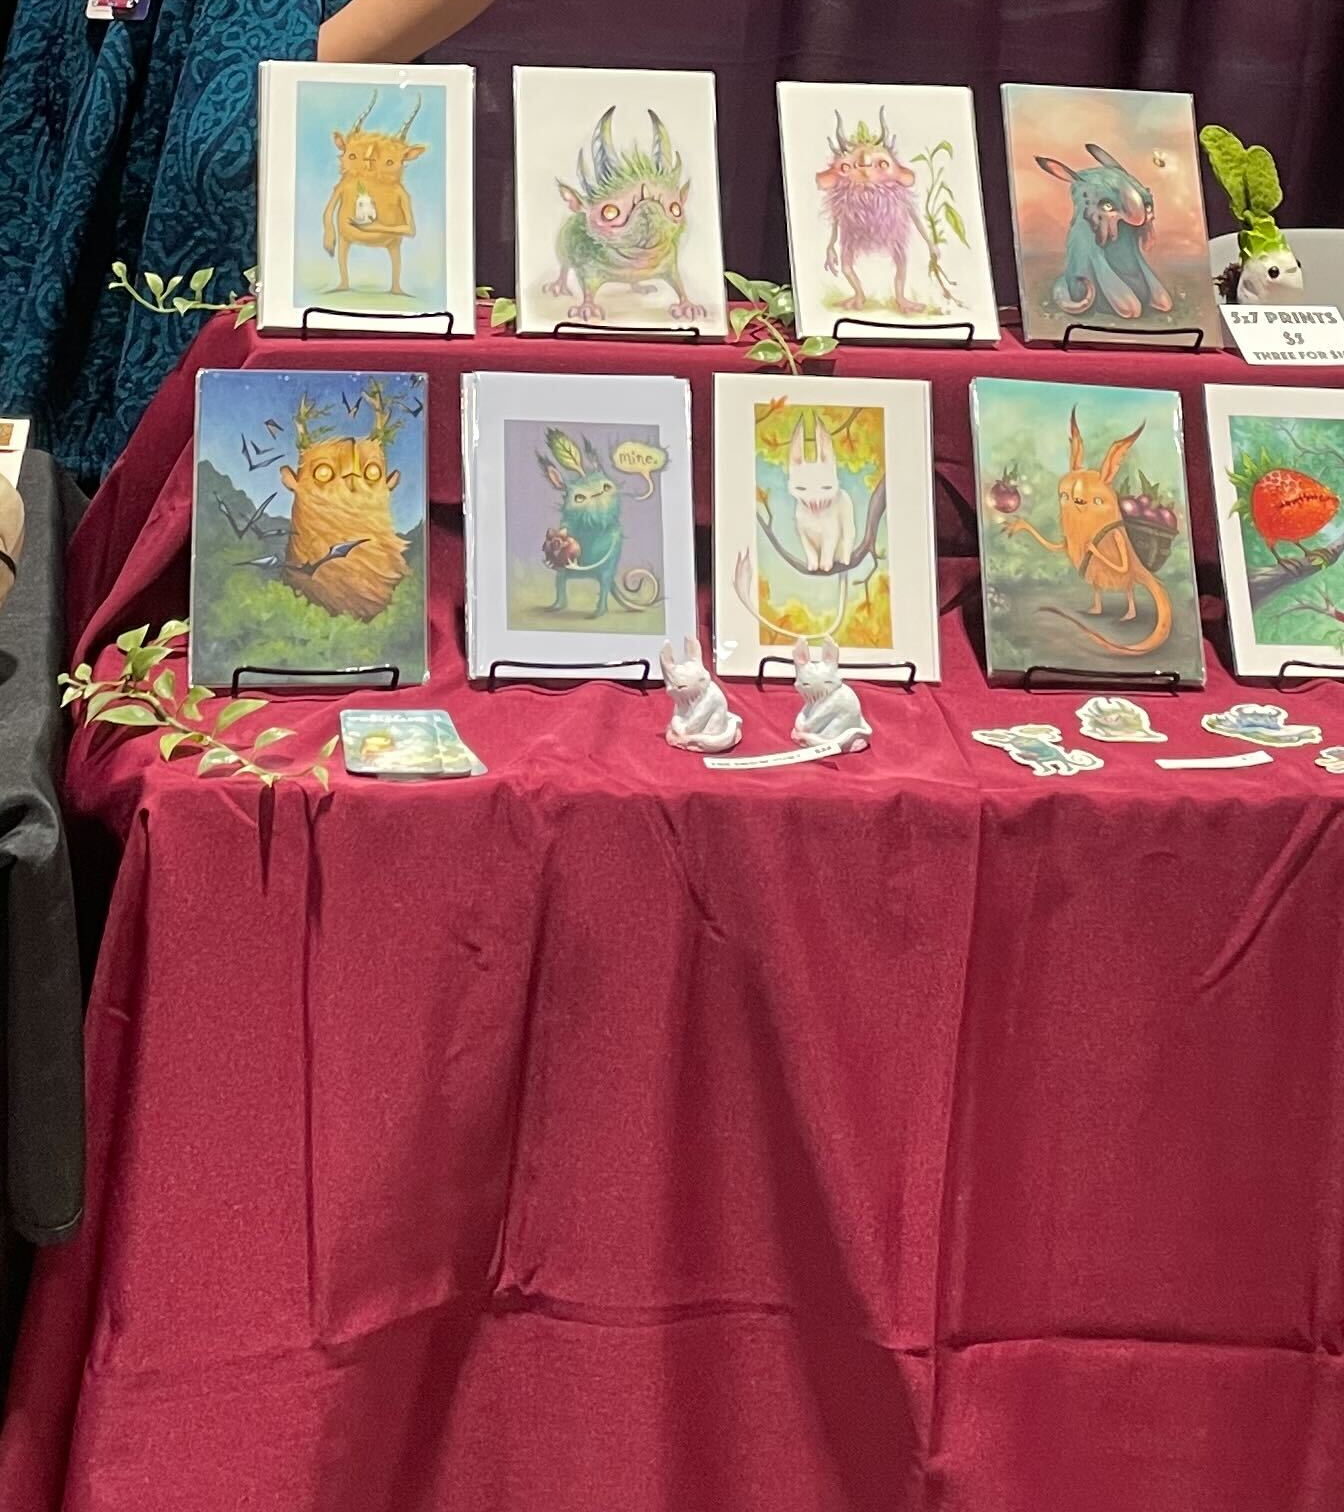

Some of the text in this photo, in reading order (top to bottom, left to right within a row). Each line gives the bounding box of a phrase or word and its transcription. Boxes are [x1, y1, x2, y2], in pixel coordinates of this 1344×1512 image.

[1264, 311, 1338, 324] PRINTS
[1253, 351, 1296, 360] THREE
[1298, 351, 1328, 360] FOR
[619, 450, 659, 466] mine.
